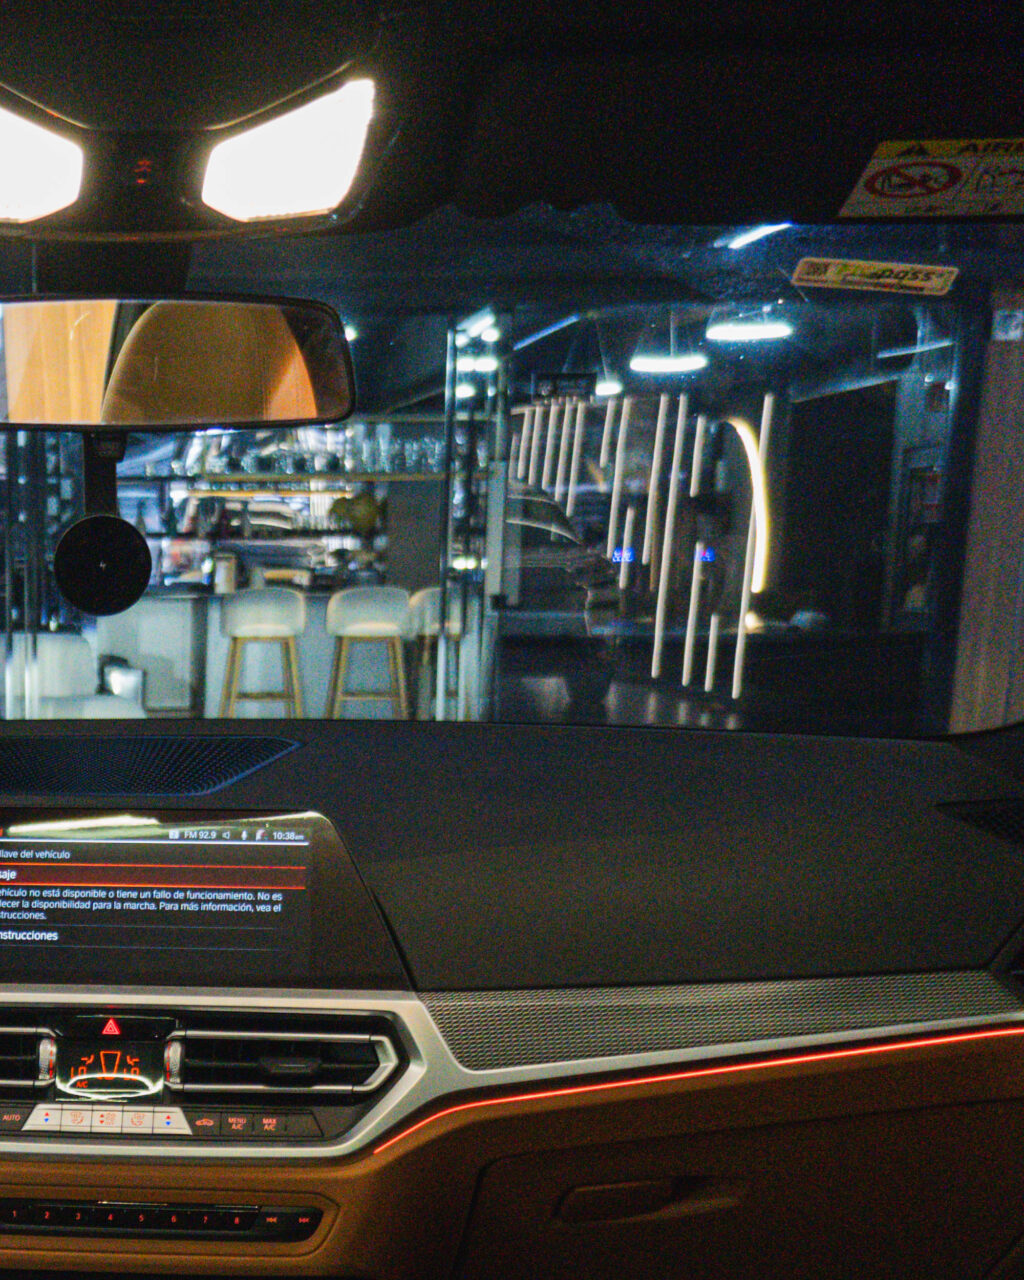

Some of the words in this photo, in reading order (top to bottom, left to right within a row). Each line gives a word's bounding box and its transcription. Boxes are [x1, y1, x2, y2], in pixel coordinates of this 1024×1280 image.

[184, 831, 197, 839] FM
[199, 831, 216, 839] 92.9
[0, 850, 18, 859] llave
[20, 850, 34, 859] del
[35, 850, 71, 859] vehículo
[42, 888, 60, 897] está
[62, 888, 106, 900] disponible
[108, 890, 114, 898] o
[117, 890, 138, 899] tiene
[153, 890, 171, 899] fallo
[173, 890, 184, 899] de
[186, 890, 255, 900] funcionamiento.
[257, 892, 270, 900] No
[22, 899, 29, 908] la
[31, 900, 91, 911] disponibilidad
[92, 902, 112, 911] para
[114, 900, 121, 909] la
[123, 901, 157, 910] marcha.
[160, 902, 179, 910] Para
[181, 902, 198, 911] más
[201, 902, 254, 912] información,
[273, 903, 281, 912] el
[3, 1114, 21, 1122] AUTO
